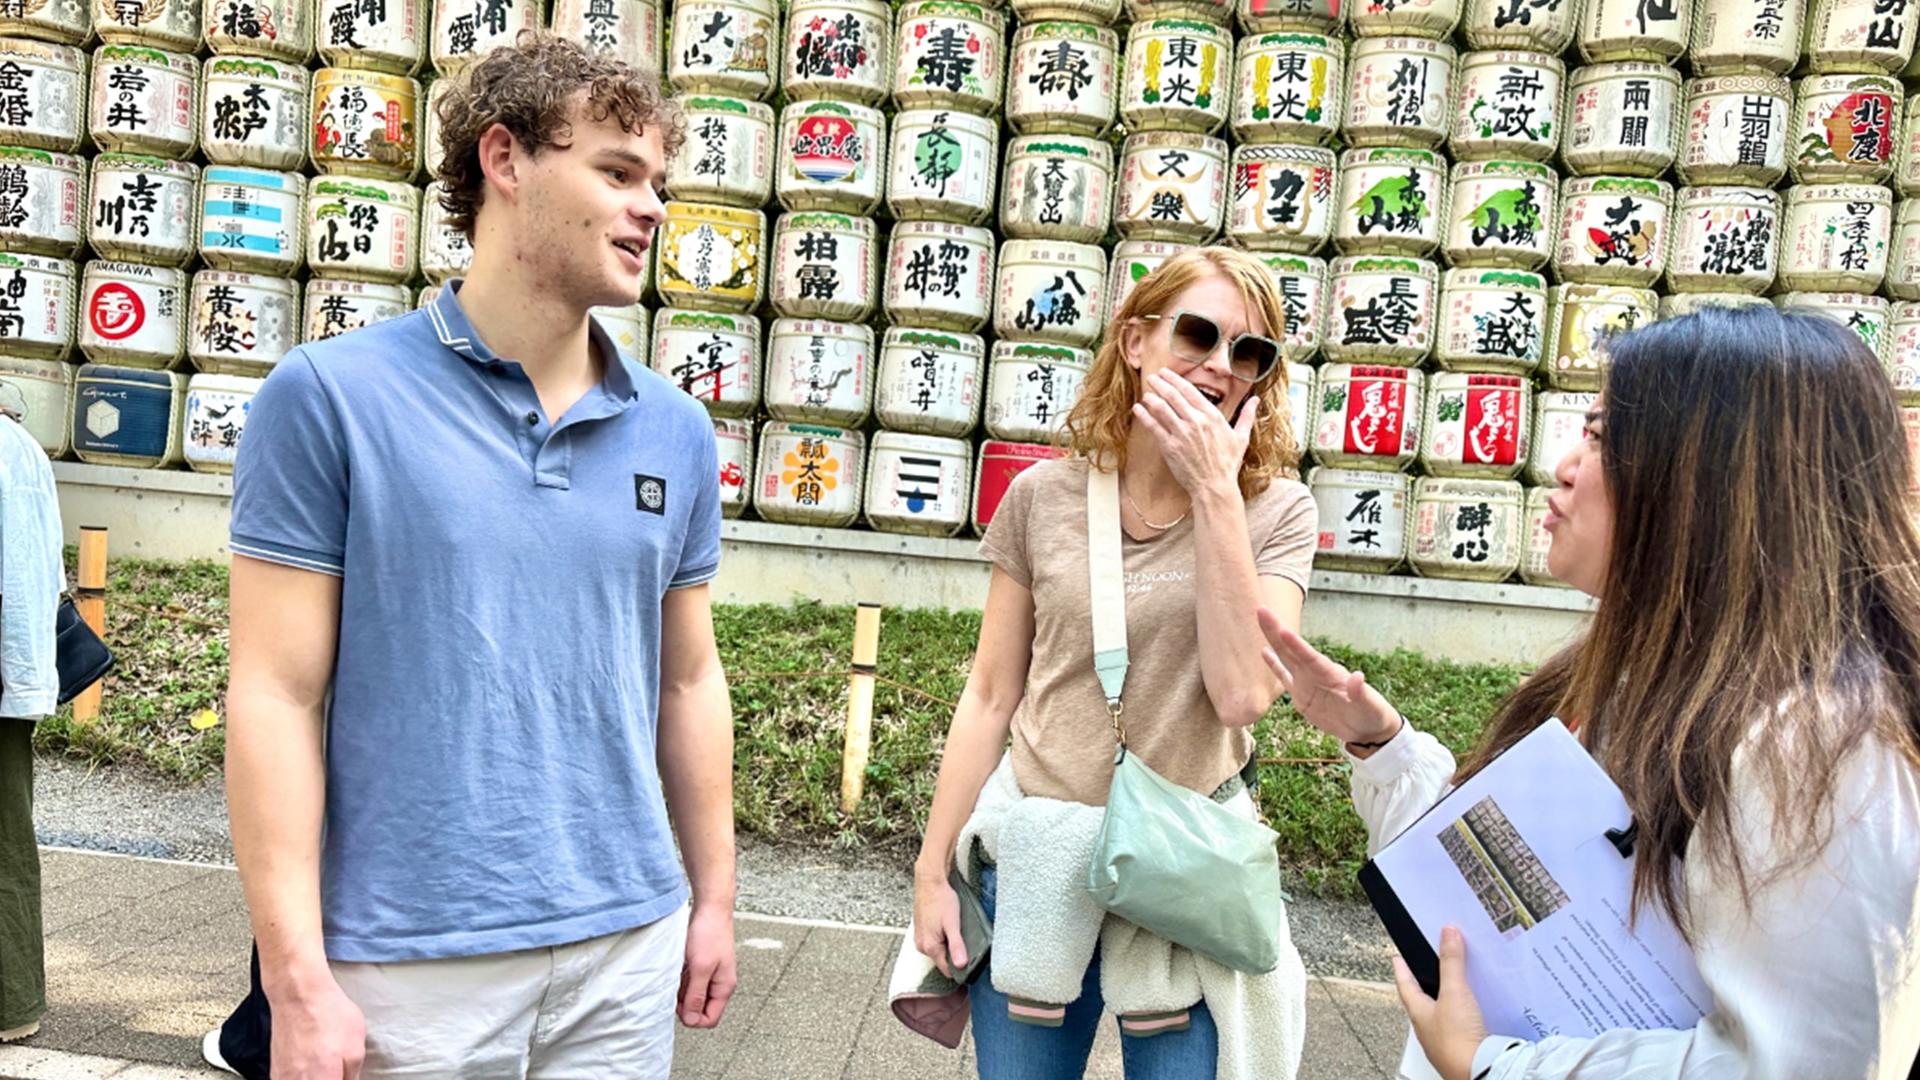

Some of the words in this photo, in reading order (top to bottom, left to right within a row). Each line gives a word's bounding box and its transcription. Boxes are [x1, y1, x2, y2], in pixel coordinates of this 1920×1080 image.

[107, 64, 150, 130] 岩の井
[1163, 36, 1199, 107] 東光
[1272, 51, 1308, 122] 東光
[1493, 67, 1545, 141] 新政
[693, 116, 729, 187] 秩父錦
[1736, 95, 1773, 167] 出羽鶴
[1848, 98, 1885, 163] 北鹿
[1267, 168, 1305, 223] 力士
[794, 232, 840, 300] 柏露
[1840, 201, 1874, 271] 四季桜
[1015, 270, 1086, 332] 八海山
